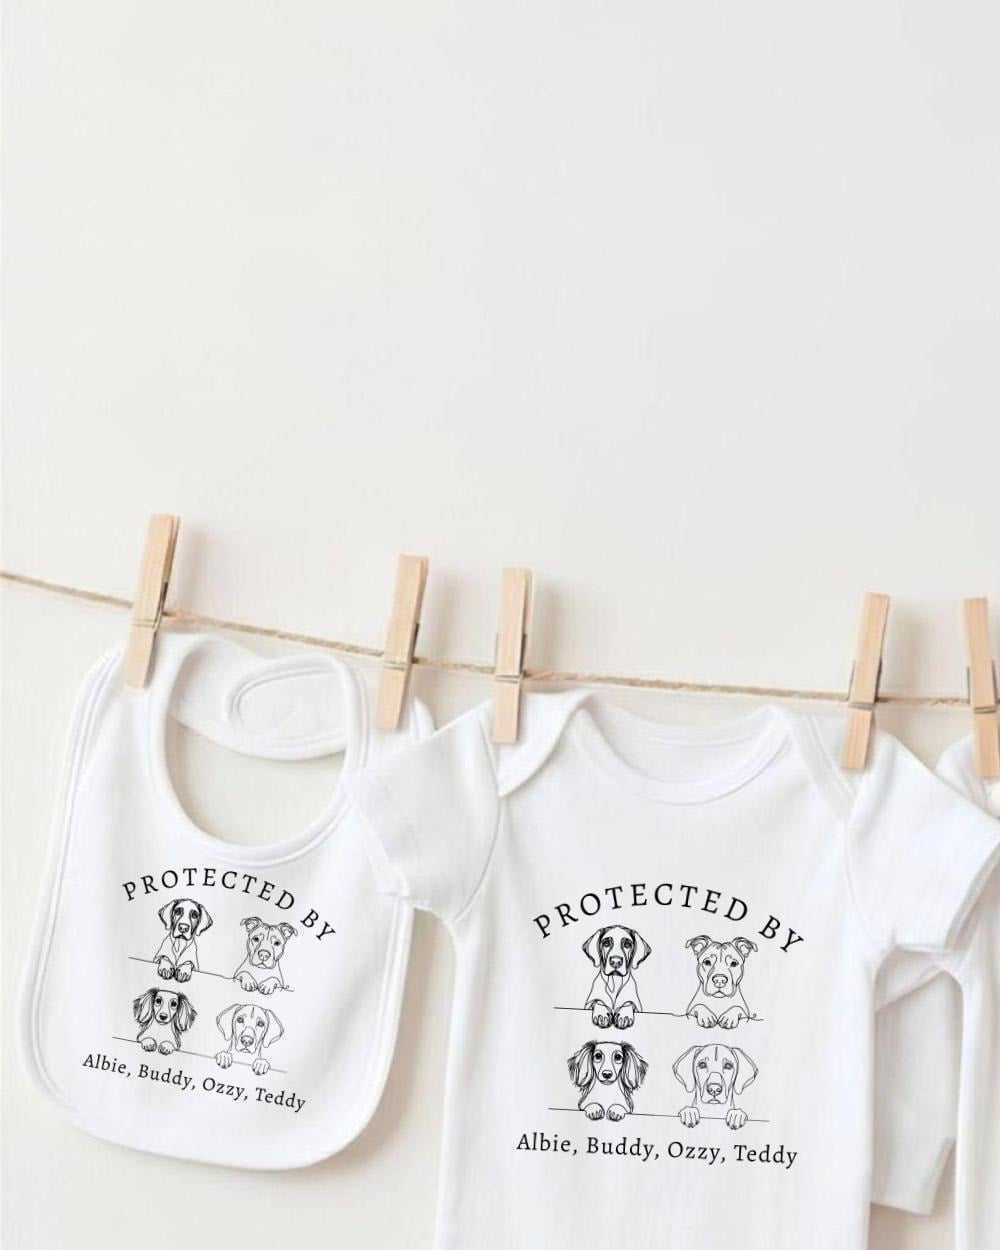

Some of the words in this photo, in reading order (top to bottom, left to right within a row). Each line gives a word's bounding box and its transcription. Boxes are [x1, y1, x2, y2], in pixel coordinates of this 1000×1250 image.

[122, 868, 294, 909] PROTECTED
[300, 909, 336, 940] BY
[533, 883, 747, 939] PROTECTED
[758, 915, 804, 952] BY
[83, 1054, 130, 1077] Albie,
[138, 1064, 195, 1090] Buddy,
[203, 1078, 247, 1100] Ozzy,
[256, 1088, 306, 1113] Teddy
[516, 1132, 577, 1155] Albie,
[587, 1137, 659, 1161] Buddy,
[668, 1142, 725, 1165] Ozzy,
[734, 1144, 797, 1169] Teddy
